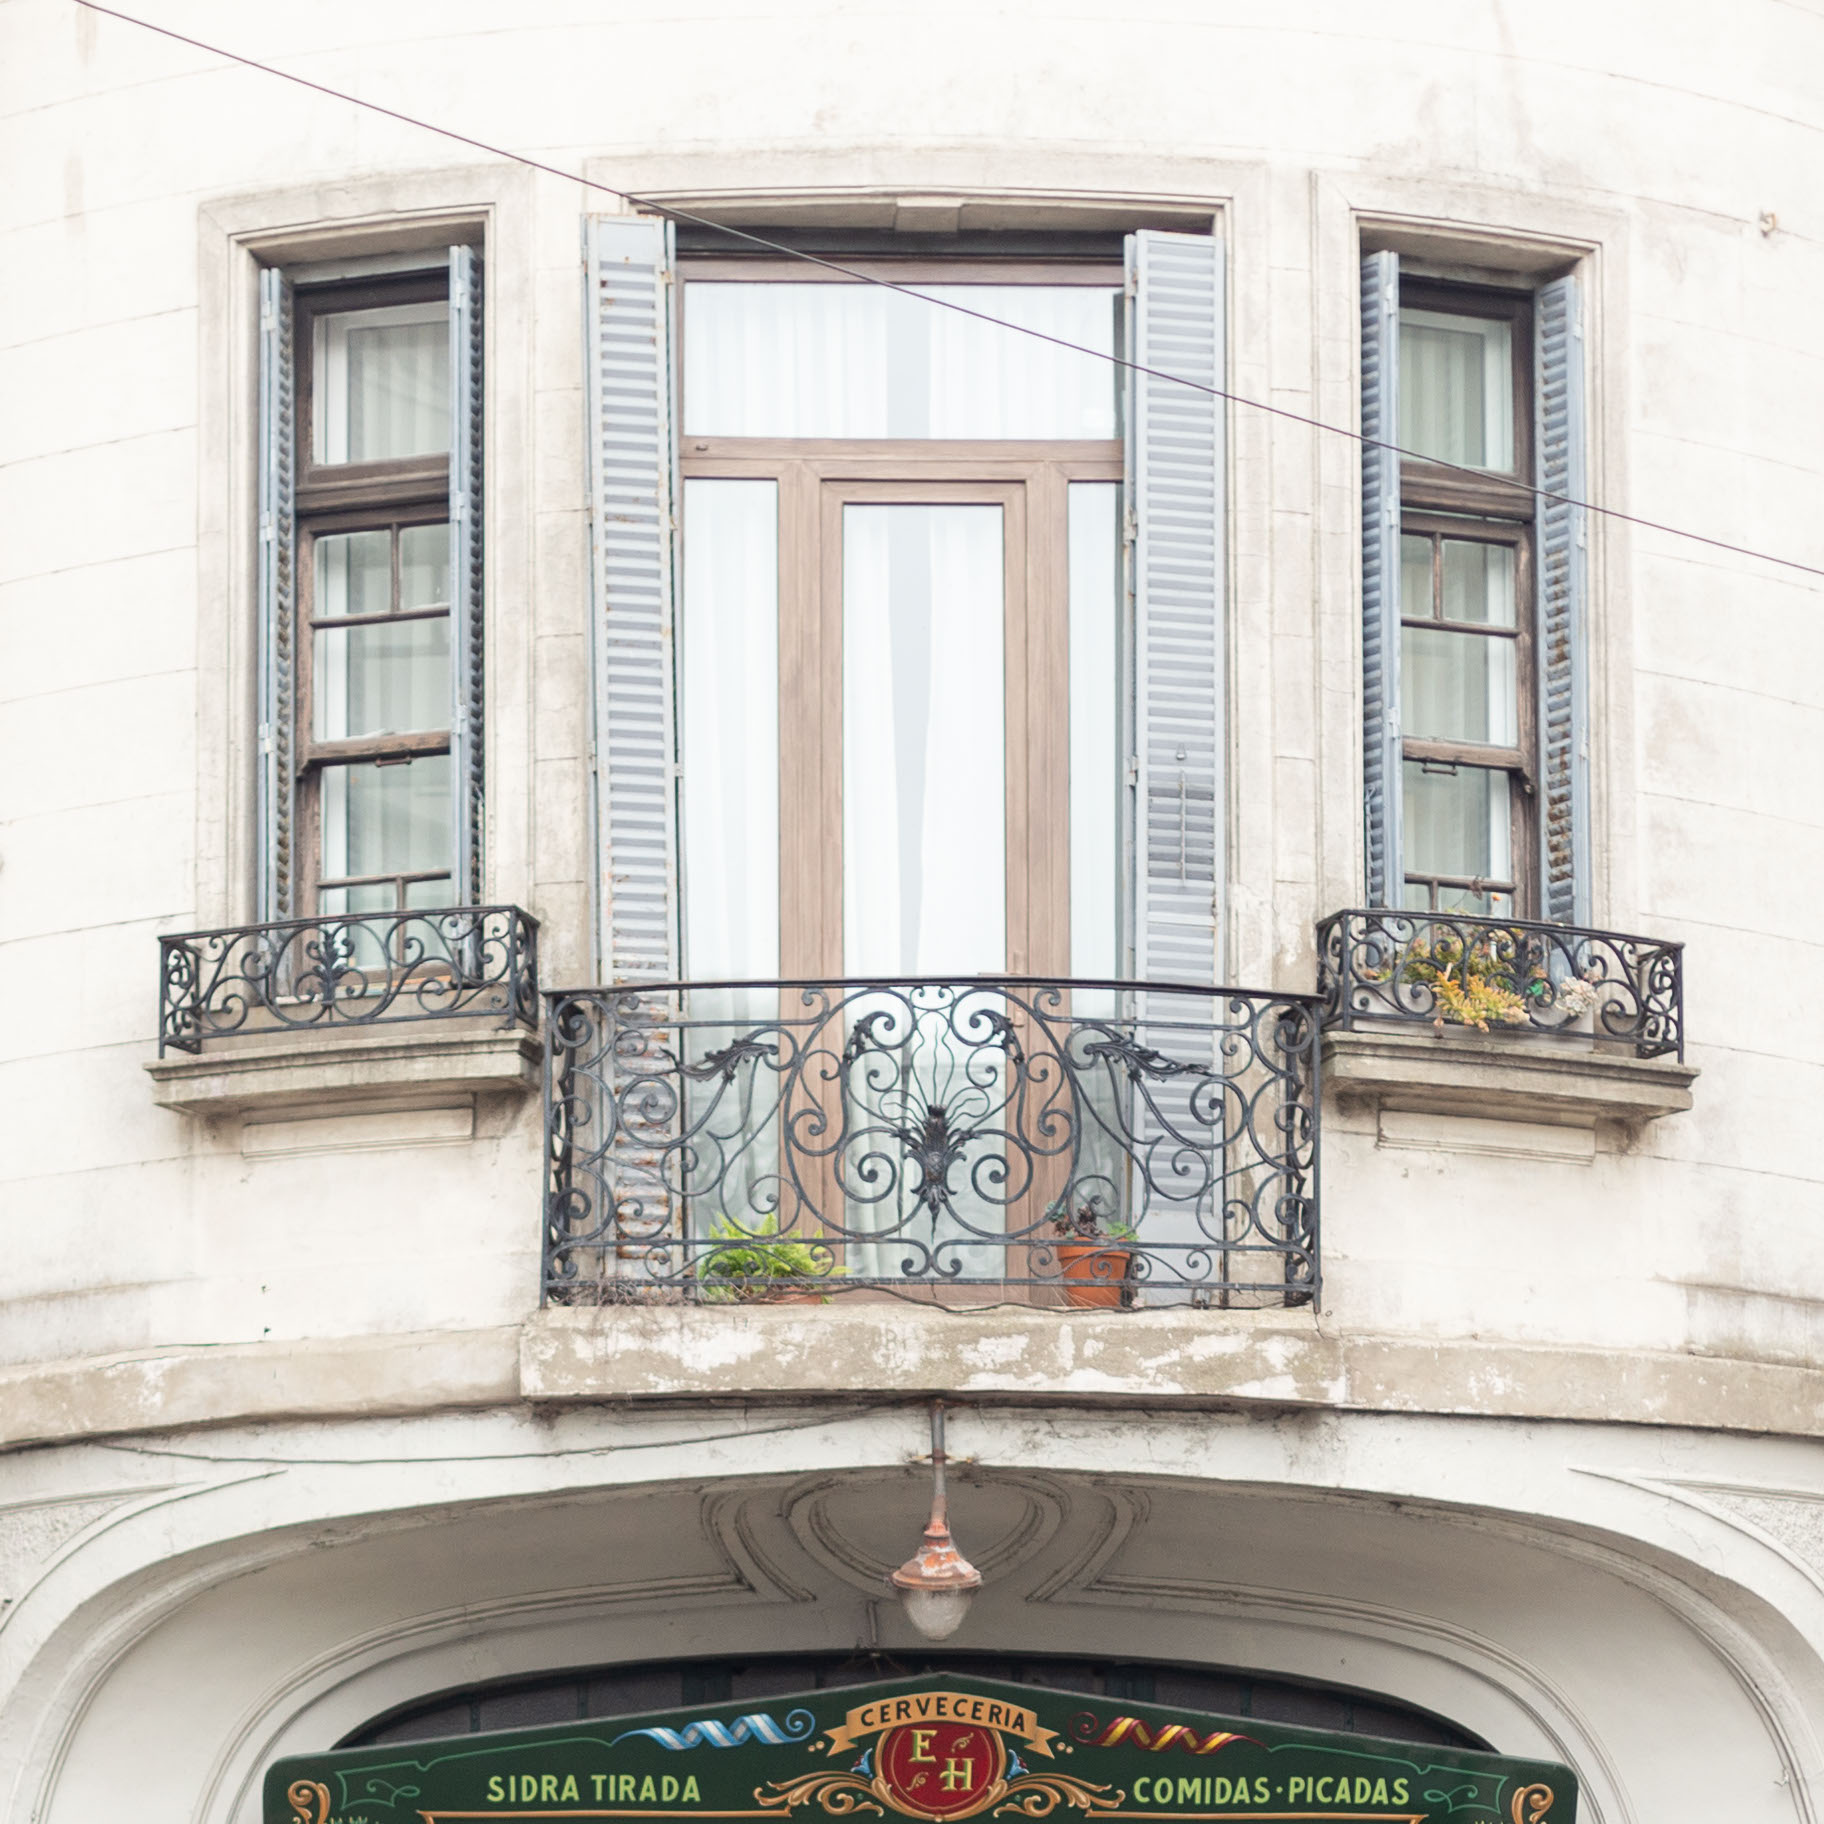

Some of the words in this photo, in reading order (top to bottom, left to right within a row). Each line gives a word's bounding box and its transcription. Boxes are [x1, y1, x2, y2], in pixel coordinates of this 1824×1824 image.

[860, 1696, 1028, 1732] CERVECERIA
[487, 1774, 580, 1803] SIDRA
[592, 1774, 701, 1803] TIRADA
